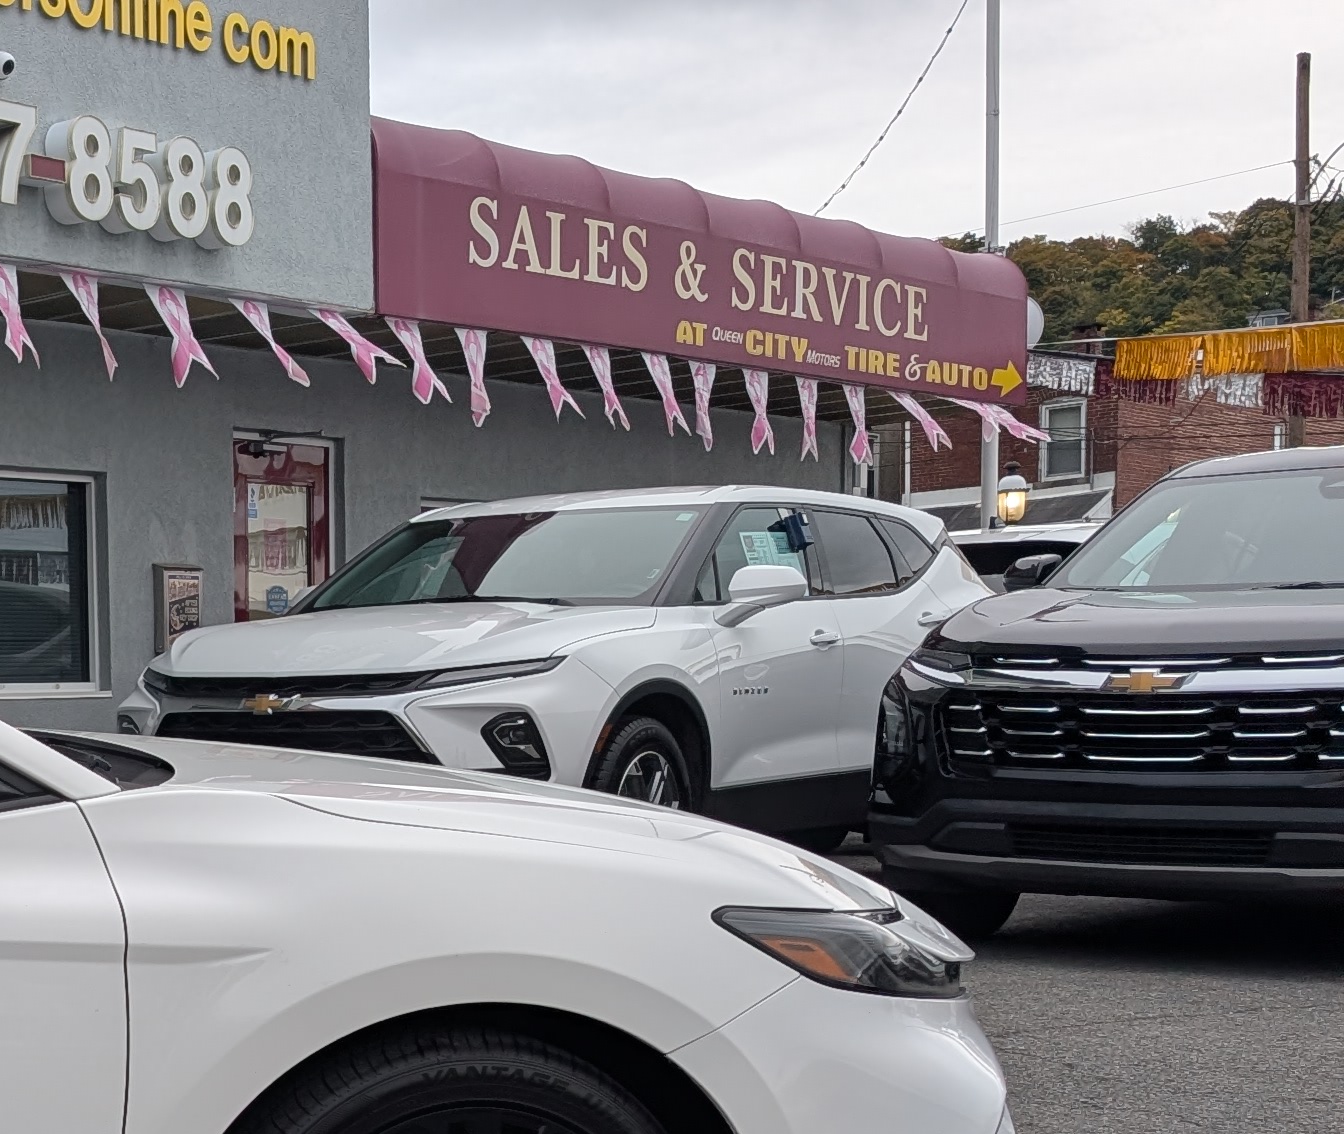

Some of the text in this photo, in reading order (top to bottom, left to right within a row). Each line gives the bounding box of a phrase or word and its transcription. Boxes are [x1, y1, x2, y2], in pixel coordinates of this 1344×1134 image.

[223, 12, 317, 80] com
[468, 196, 929, 342] SALES & SERVICE
[675, 320, 988, 391] AT QUEEN CITY MOTORS TIRE & AUTO
[421, 1065, 570, 1093] VANTAGE
